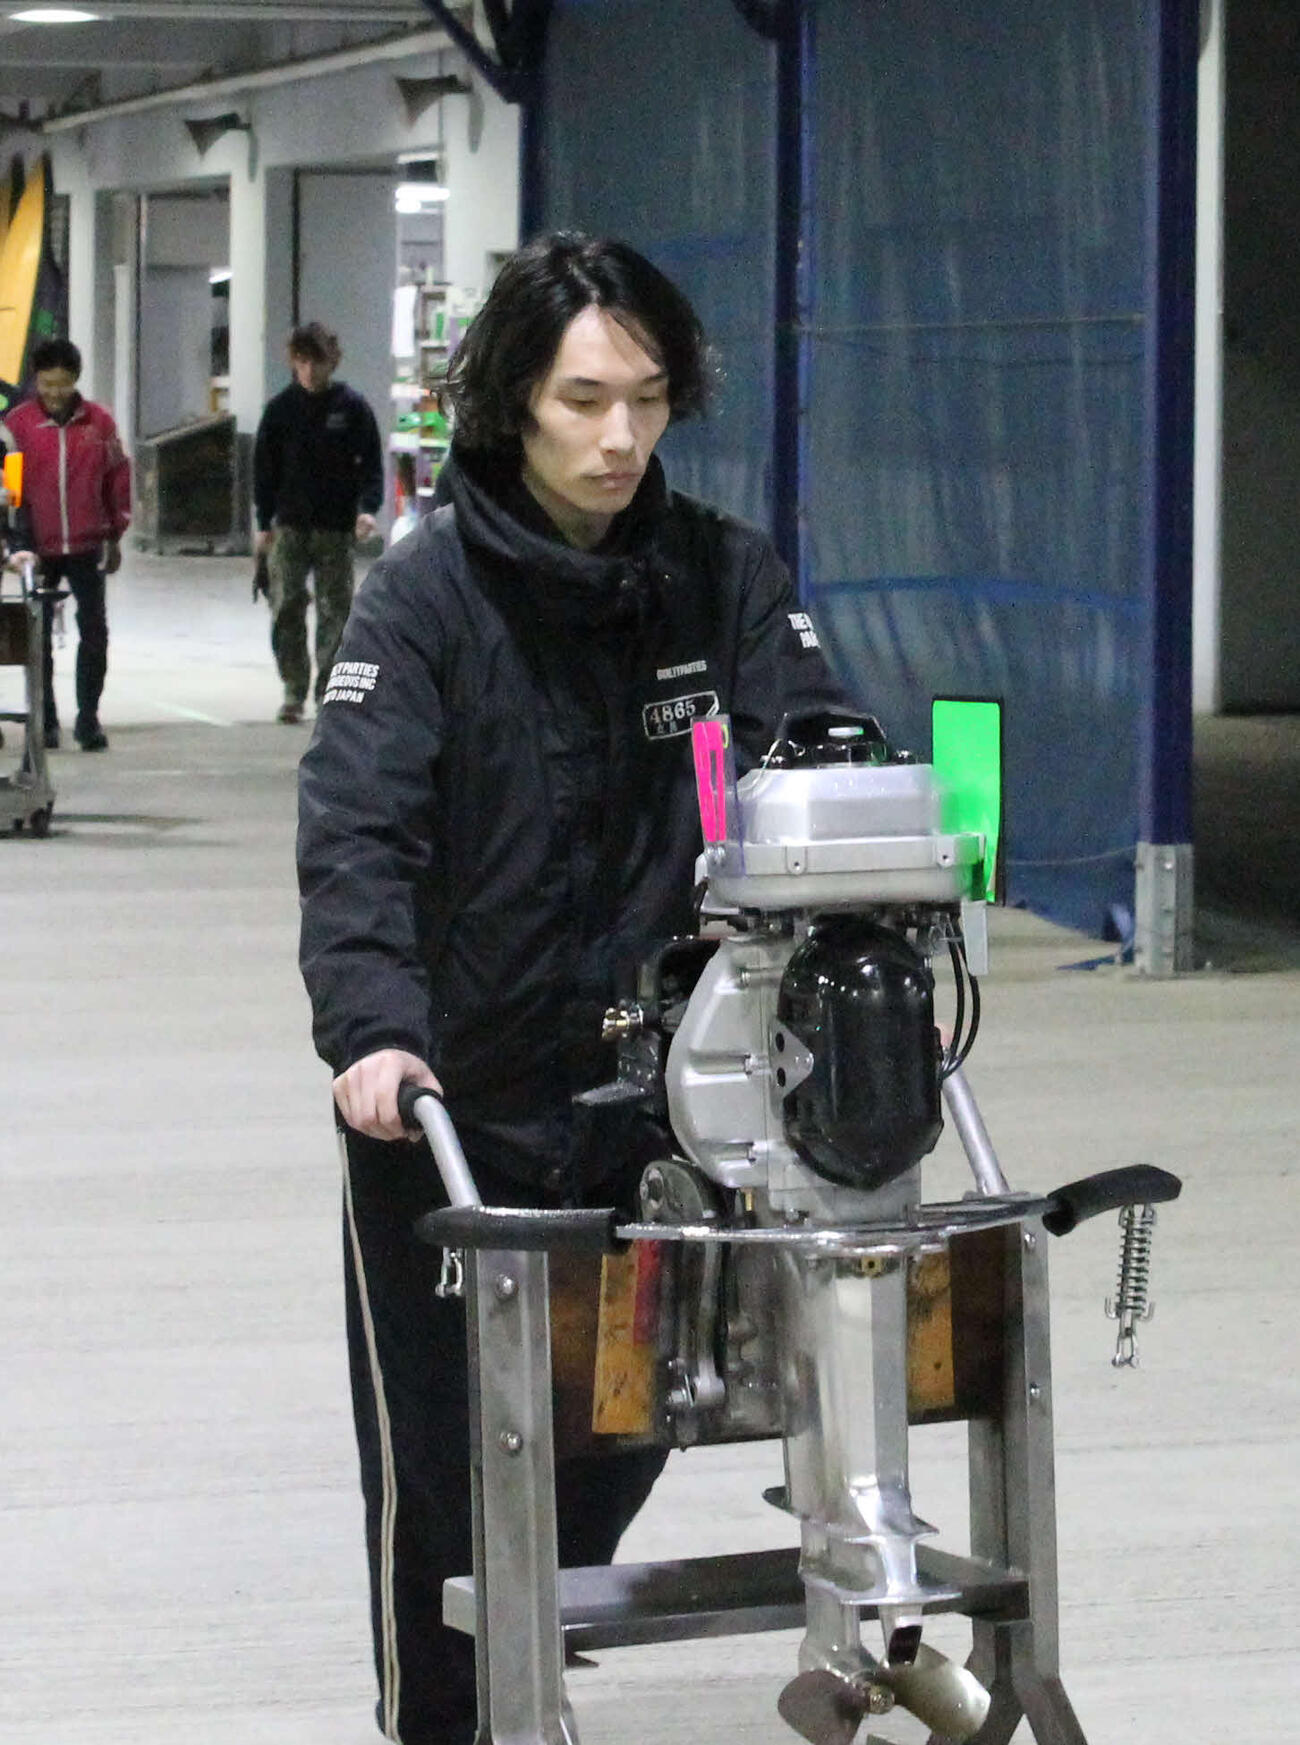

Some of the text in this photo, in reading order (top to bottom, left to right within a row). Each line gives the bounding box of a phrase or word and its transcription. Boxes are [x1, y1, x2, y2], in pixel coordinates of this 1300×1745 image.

[342, 662, 380, 677] PARTIES
[335, 689, 365, 703] JAPAN
[650, 700, 696, 723] 4865
